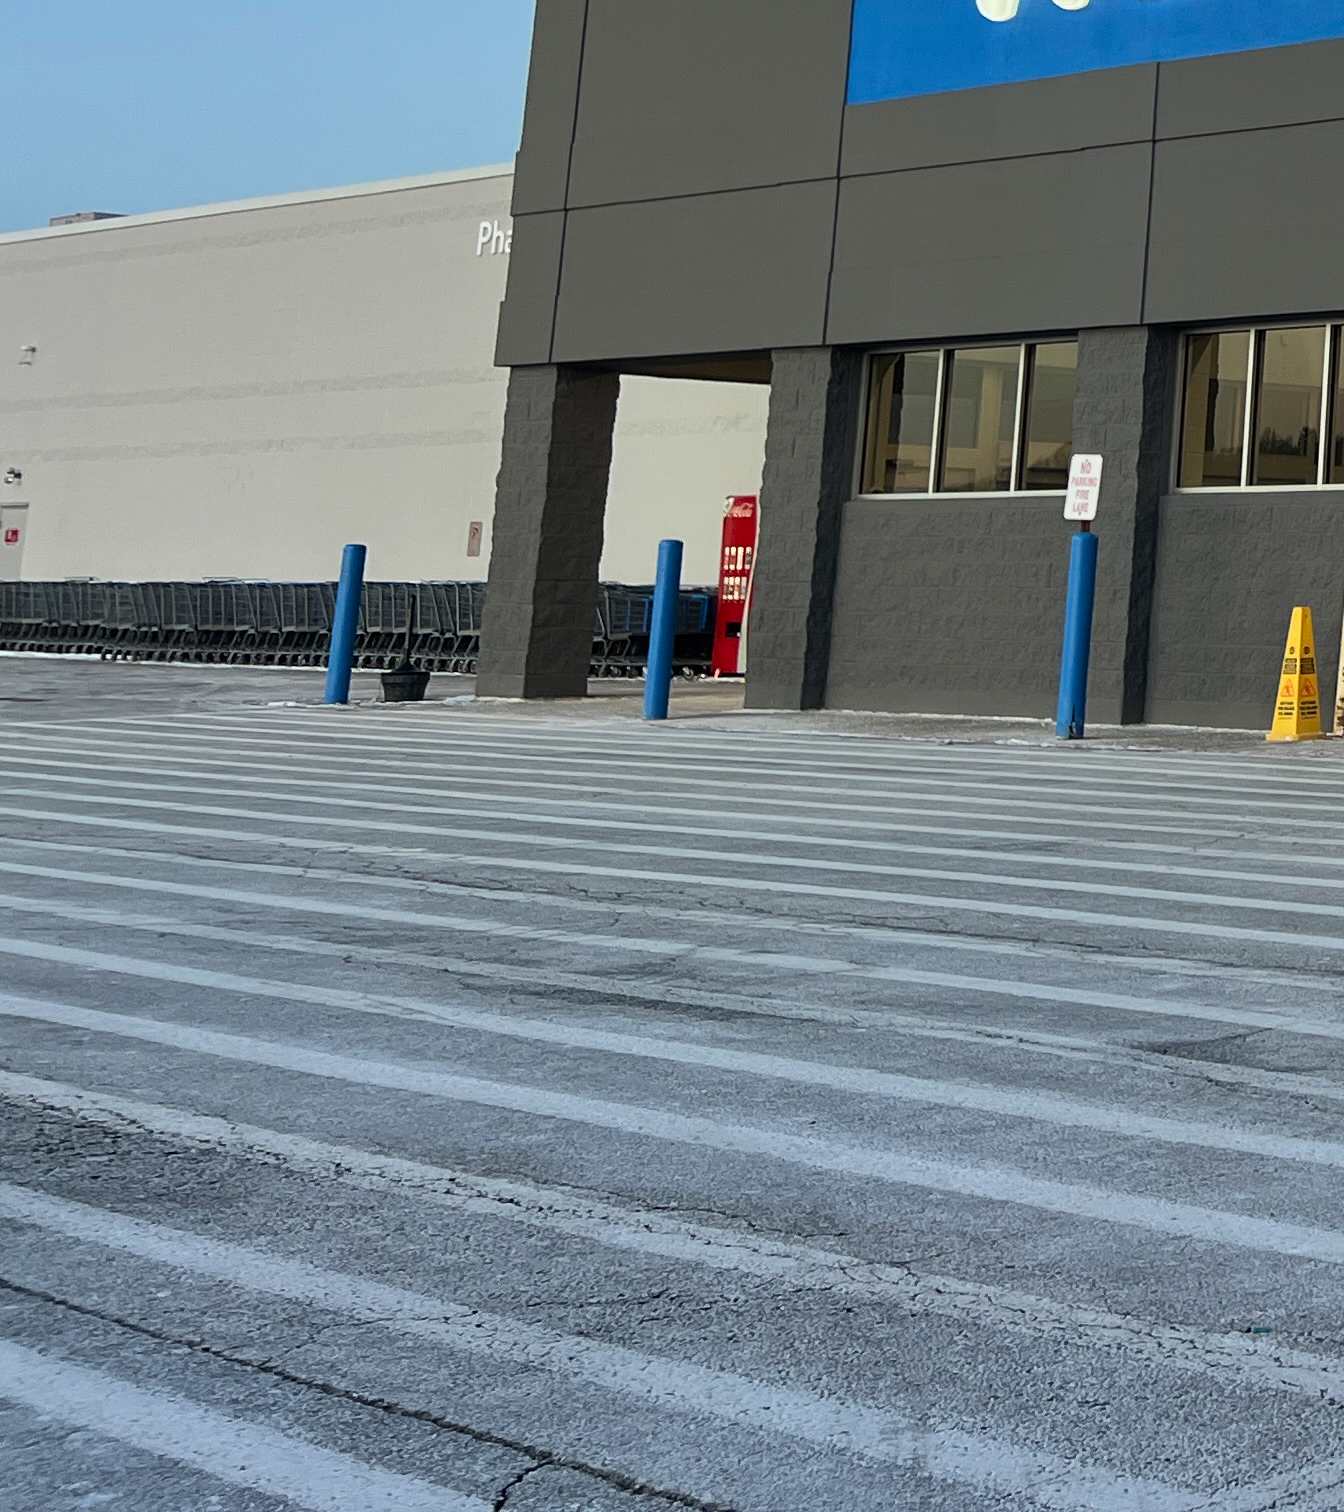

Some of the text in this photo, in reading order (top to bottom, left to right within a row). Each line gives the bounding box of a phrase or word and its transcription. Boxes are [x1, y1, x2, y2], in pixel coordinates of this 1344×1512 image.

[1080, 462, 1092, 474] NO
[1071, 477, 1098, 487] PARKING
[1076, 489, 1090, 500] FIRE
[1072, 502, 1089, 513] LANE
